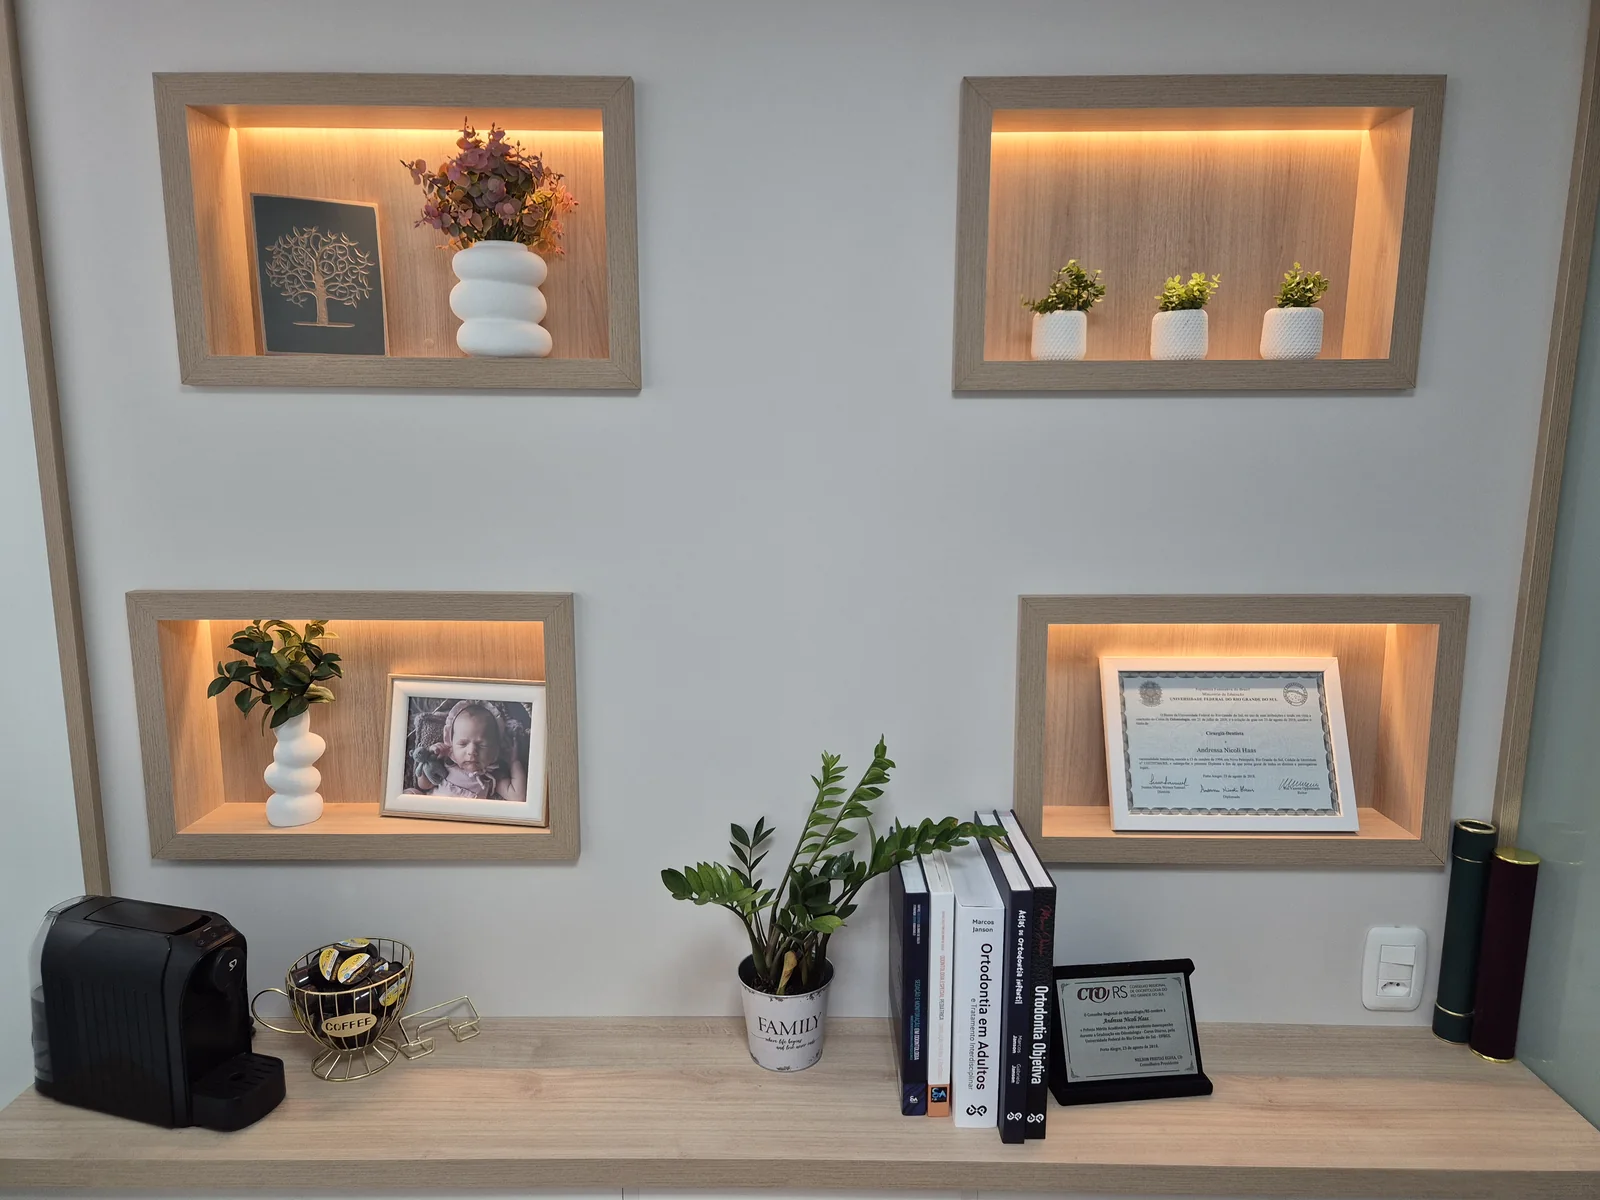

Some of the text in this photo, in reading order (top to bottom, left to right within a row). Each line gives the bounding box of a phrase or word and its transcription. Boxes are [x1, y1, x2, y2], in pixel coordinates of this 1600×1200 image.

[1017, 910, 1026, 928] Atlas
[1112, 985, 1128, 999] RS
[325, 1016, 372, 1031] COFFEE
[758, 1012, 821, 1035] FAMILY
[976, 944, 992, 1090] Ortodontia em Adultos
[1029, 986, 1049, 1084] Ortodontia Objetiva
[967, 1042, 976, 1090] Interdisciplinar
